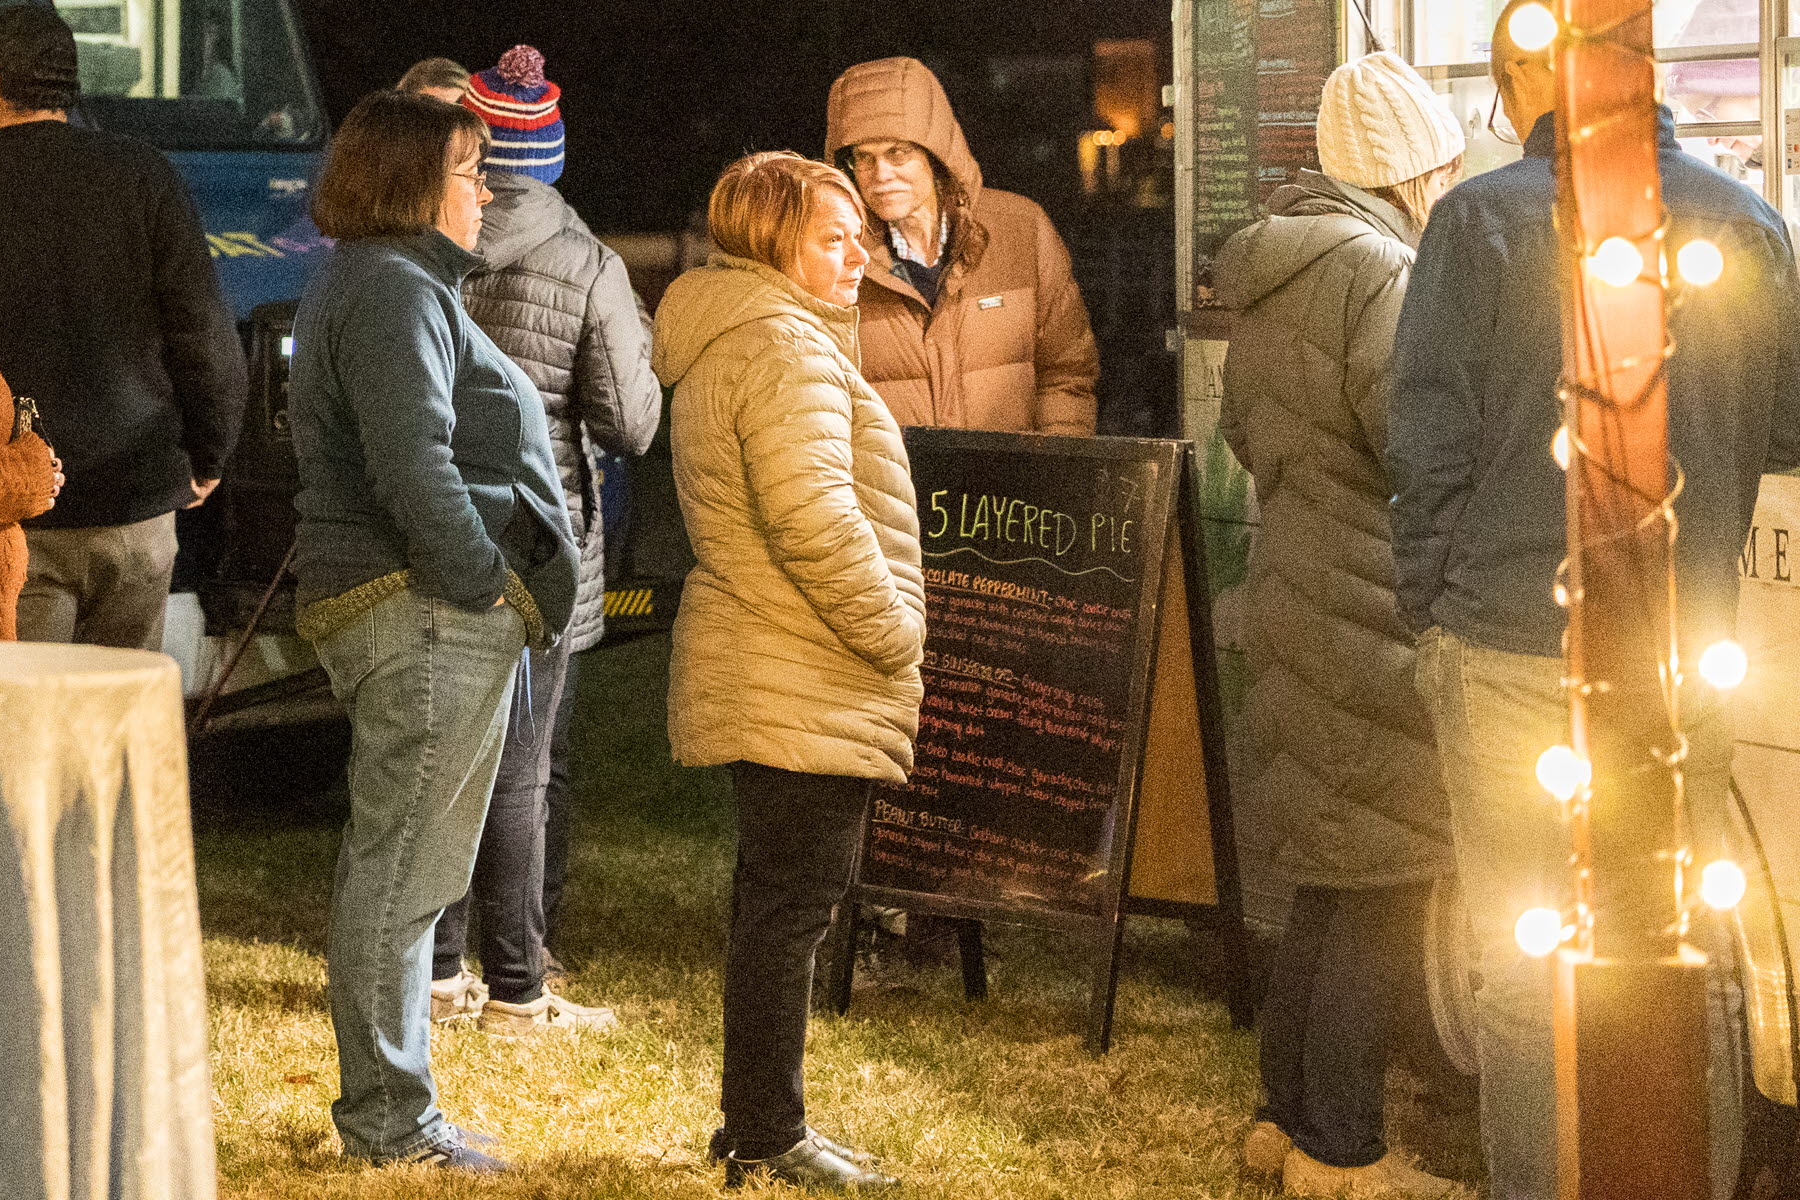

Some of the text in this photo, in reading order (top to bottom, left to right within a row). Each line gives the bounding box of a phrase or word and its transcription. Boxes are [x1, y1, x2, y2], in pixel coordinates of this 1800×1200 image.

[927, 489, 1134, 556] 5 LAYERED PIE
